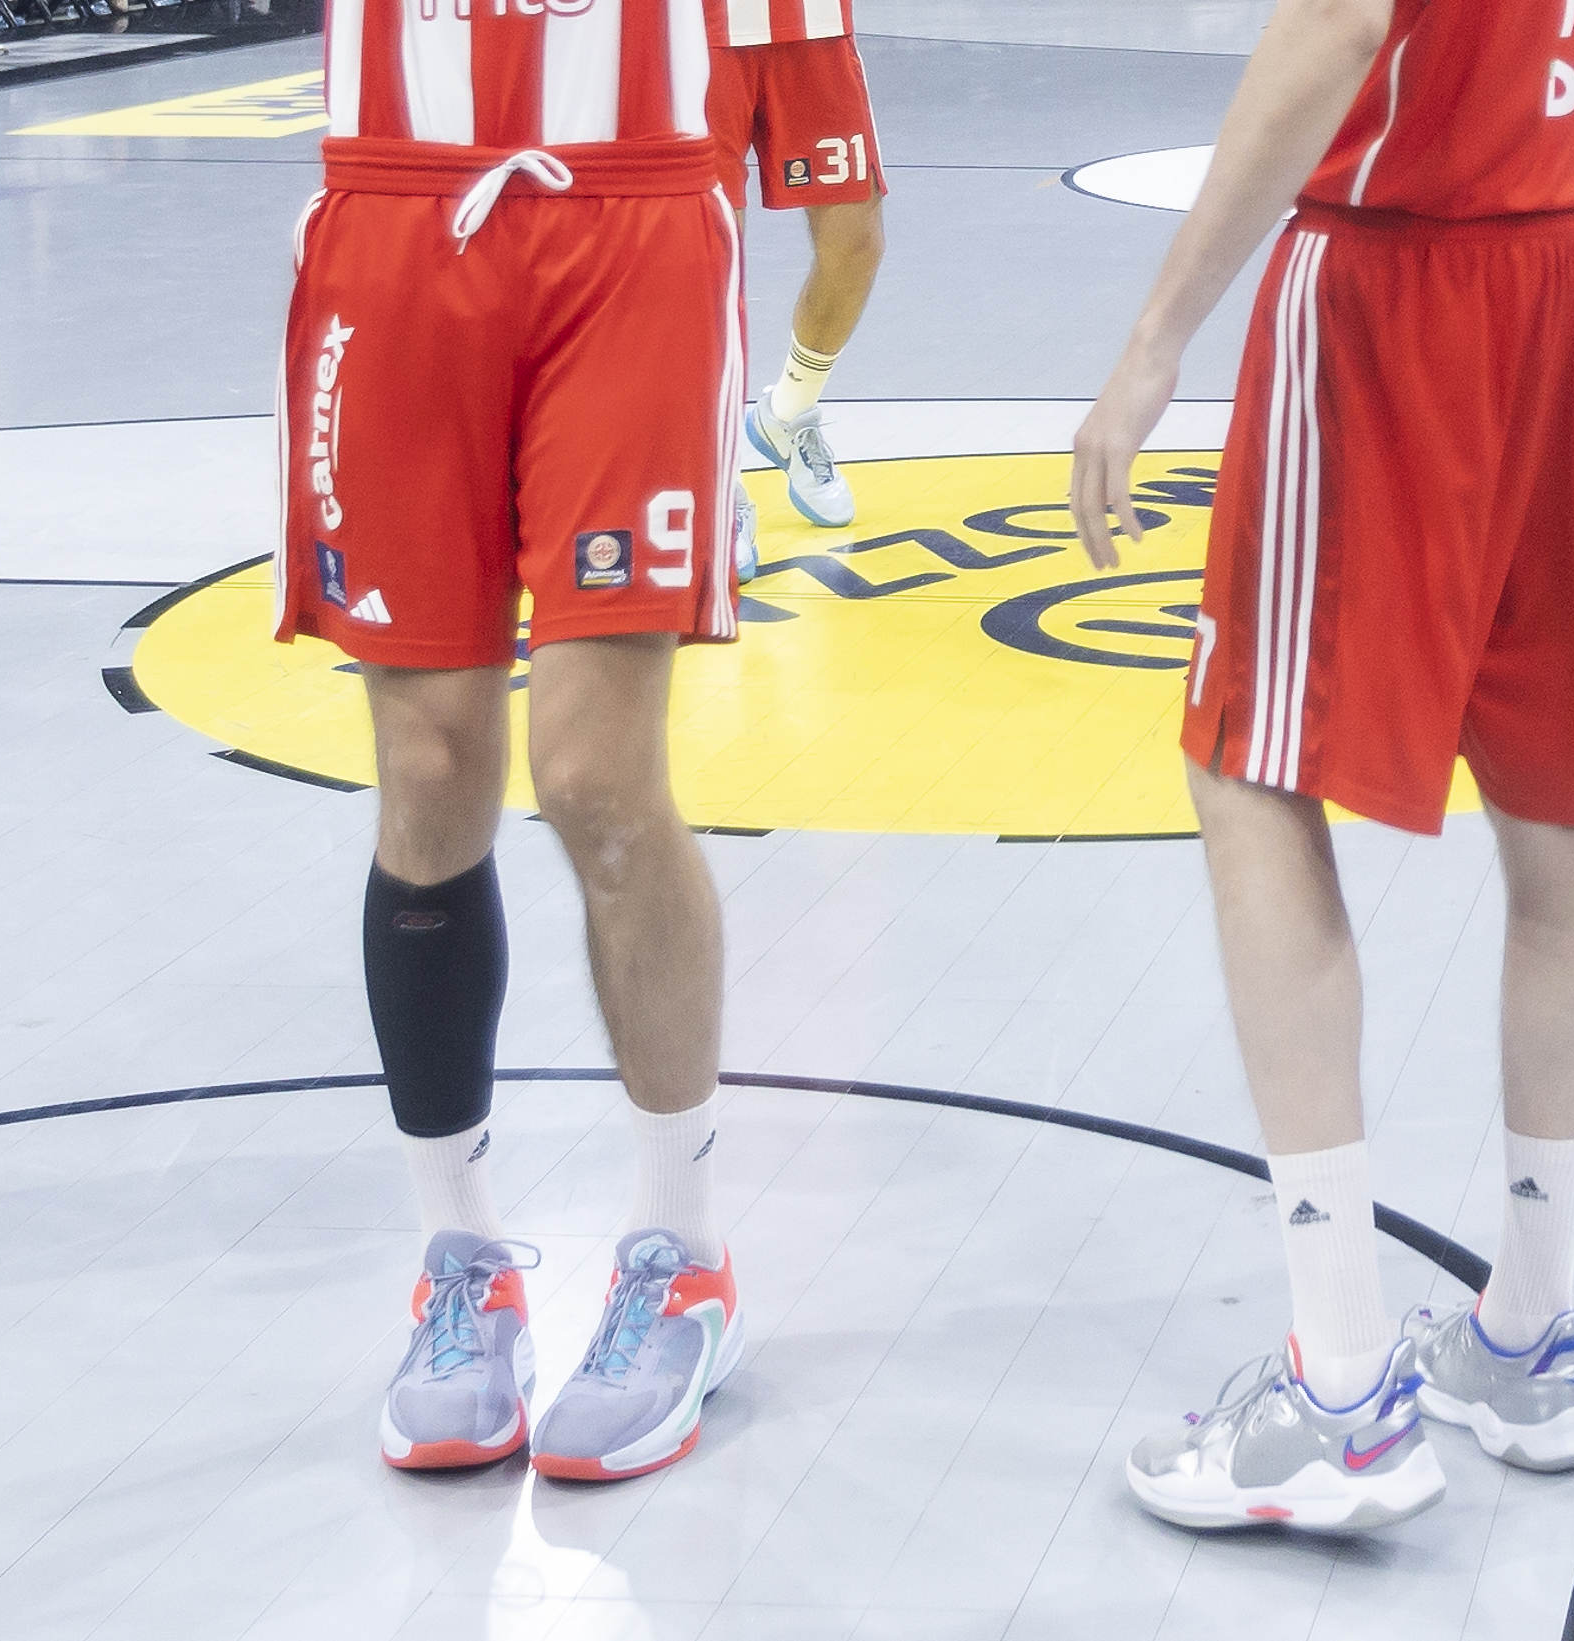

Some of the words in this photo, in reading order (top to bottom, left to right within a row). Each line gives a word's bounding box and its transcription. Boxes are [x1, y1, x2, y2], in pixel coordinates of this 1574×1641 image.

[815, 133, 868, 185] 31
[309, 313, 356, 532] carnex
[646, 490, 694, 587] 9
